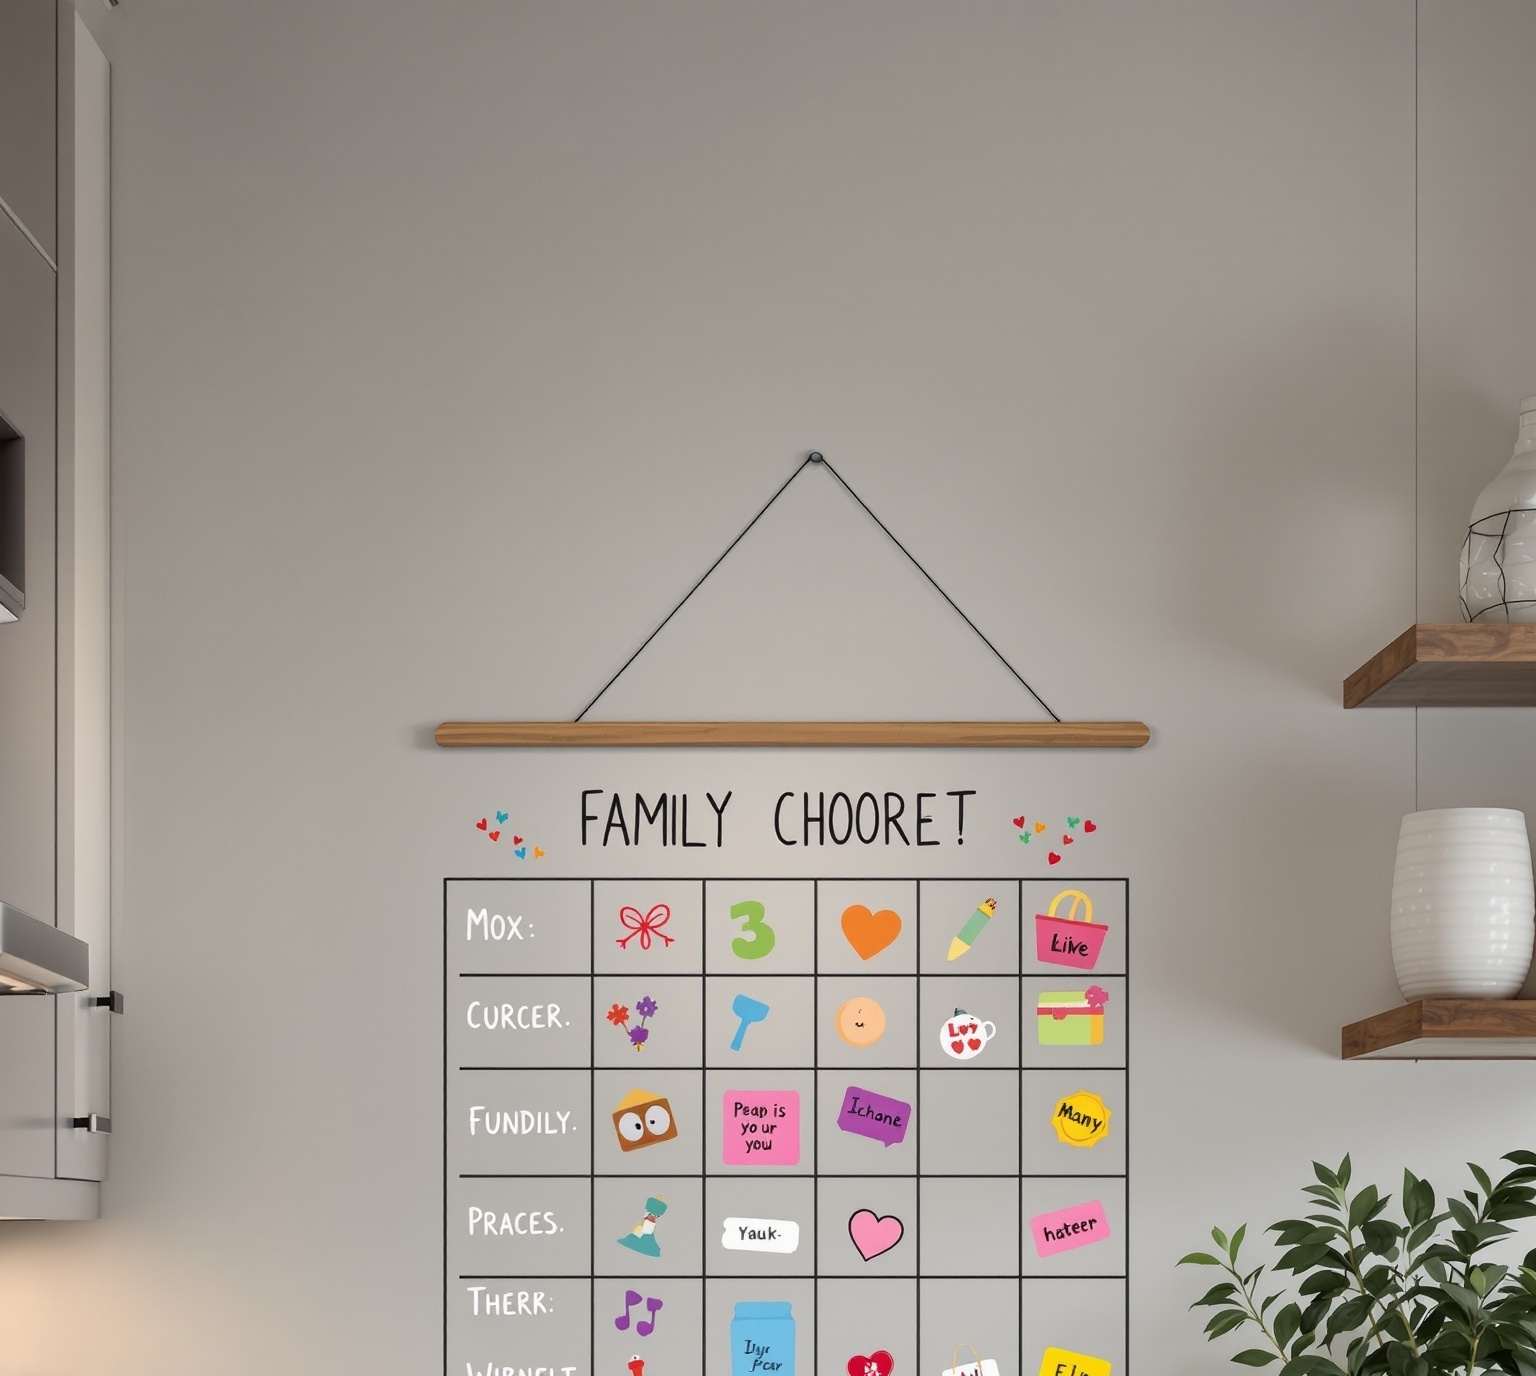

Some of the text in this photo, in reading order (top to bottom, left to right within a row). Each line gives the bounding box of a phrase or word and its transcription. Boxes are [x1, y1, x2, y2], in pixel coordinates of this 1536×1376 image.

[581, 788, 733, 848] FAMILY
[465, 907, 536, 942] MOX:
[466, 1000, 571, 1031] CURCER.
[469, 1104, 577, 1137] FUNDILY.
[1057, 1102, 1103, 1134] Many
[467, 1205, 565, 1236] PRACES.
